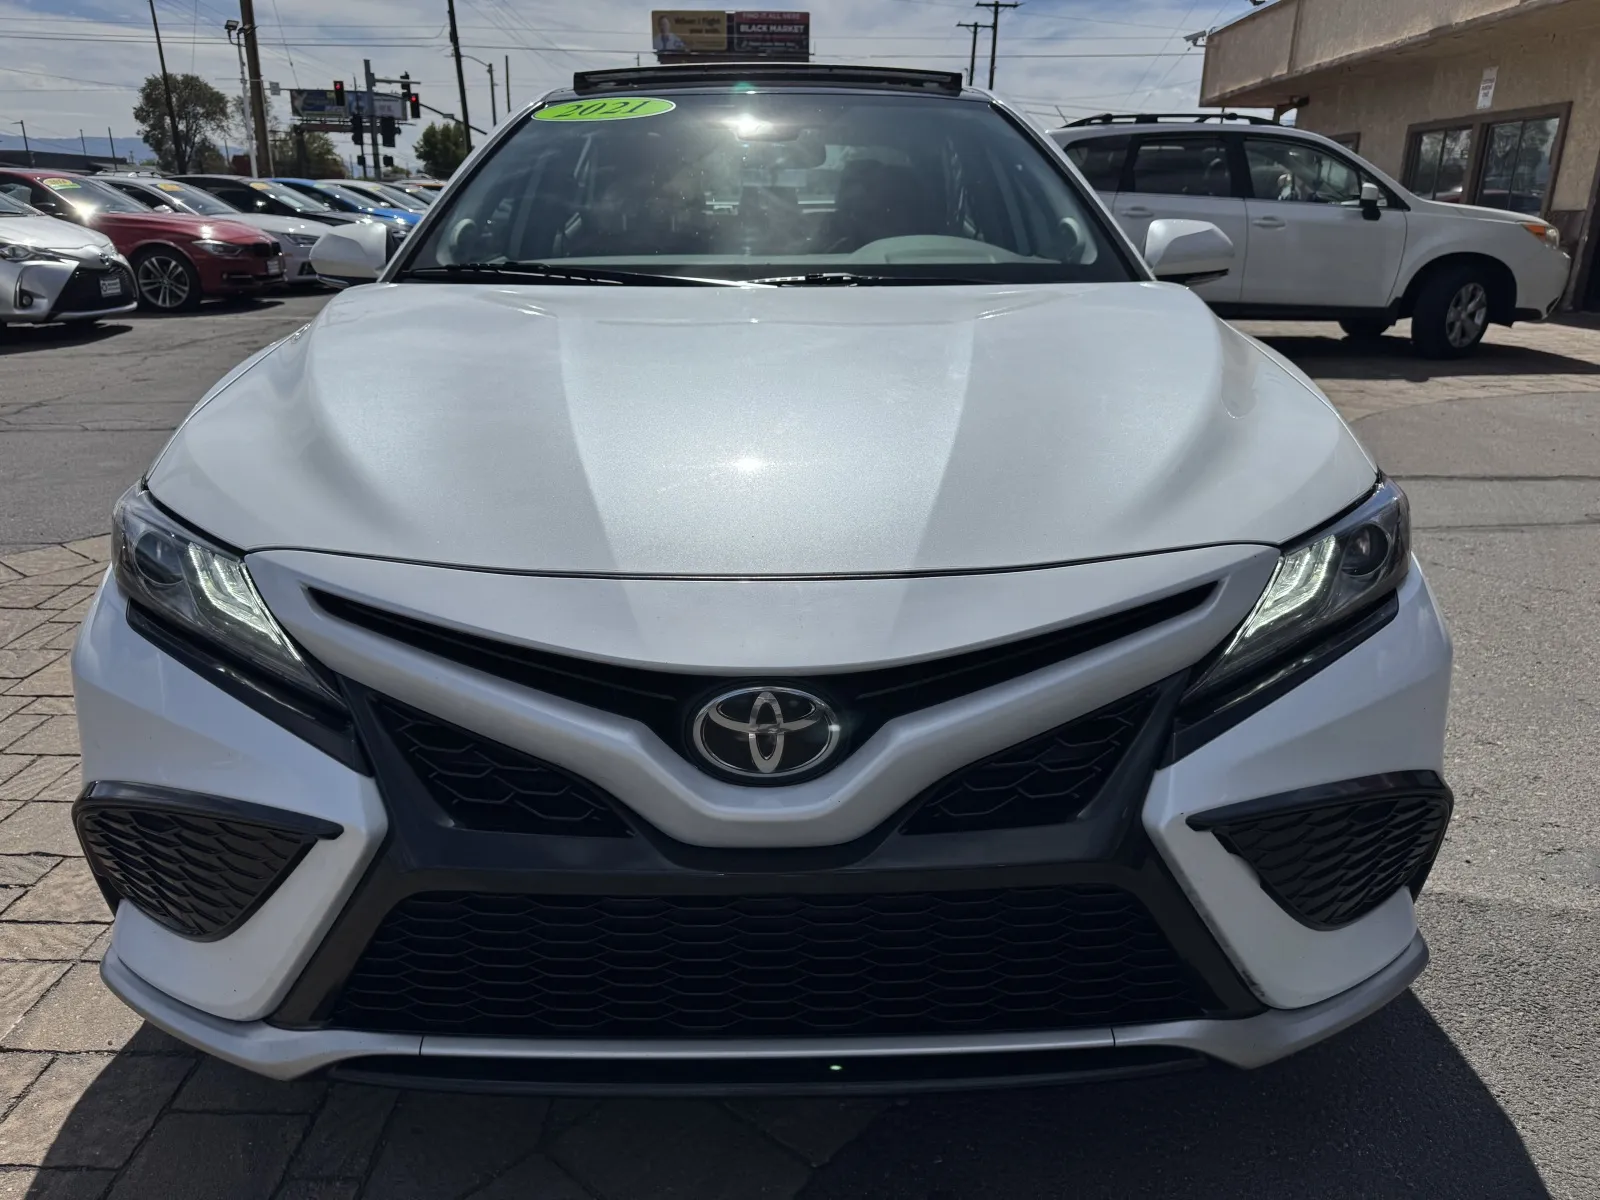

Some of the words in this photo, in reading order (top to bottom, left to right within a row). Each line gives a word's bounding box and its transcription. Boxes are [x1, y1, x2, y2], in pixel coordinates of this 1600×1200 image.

[739, 24, 768, 33] BLACK
[769, 24, 805, 33] MARKET
[554, 101, 650, 118] 2021
